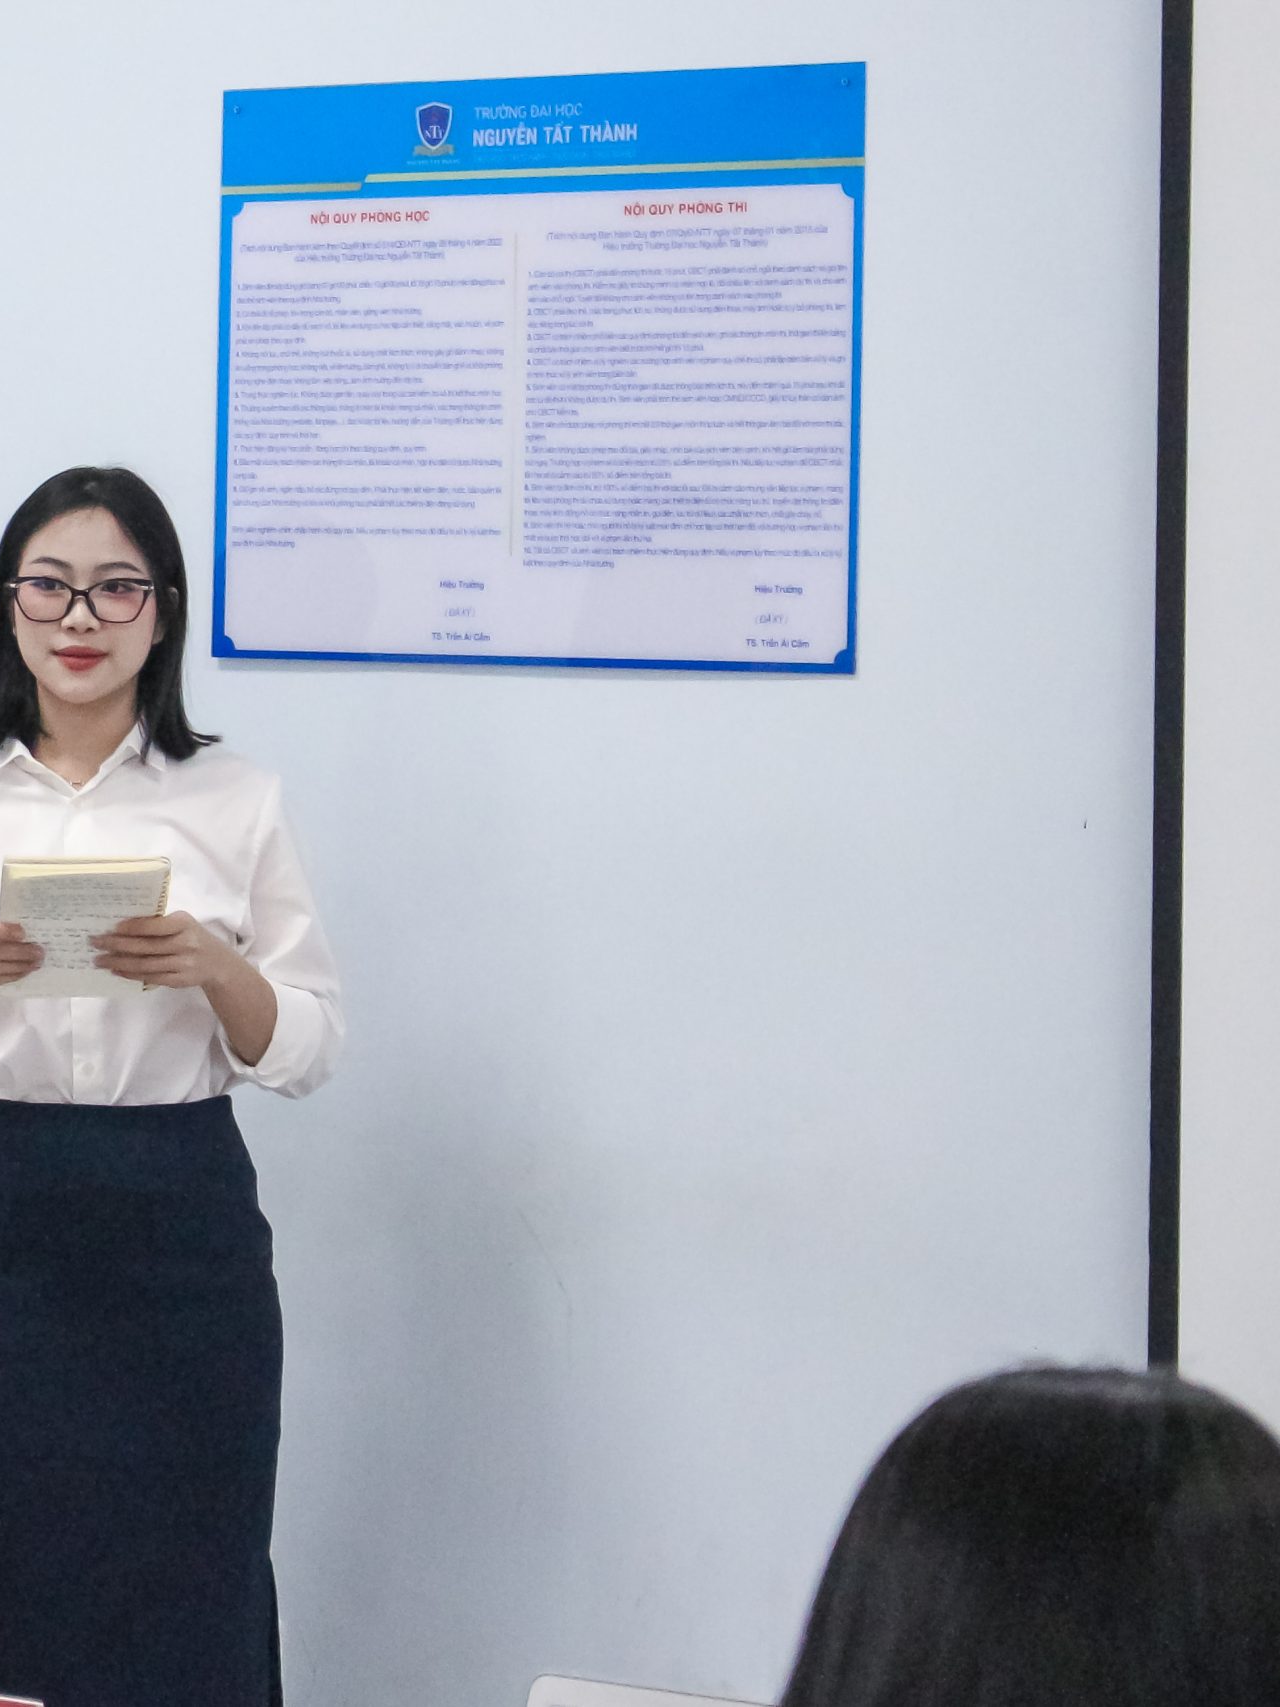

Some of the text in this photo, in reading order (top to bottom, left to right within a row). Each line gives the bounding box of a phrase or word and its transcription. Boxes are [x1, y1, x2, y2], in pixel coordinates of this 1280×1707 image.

[580, 120, 638, 143] THÀNH
[648, 203, 674, 215] QUY
[728, 201, 747, 213] THI
[333, 212, 357, 224] QUY
